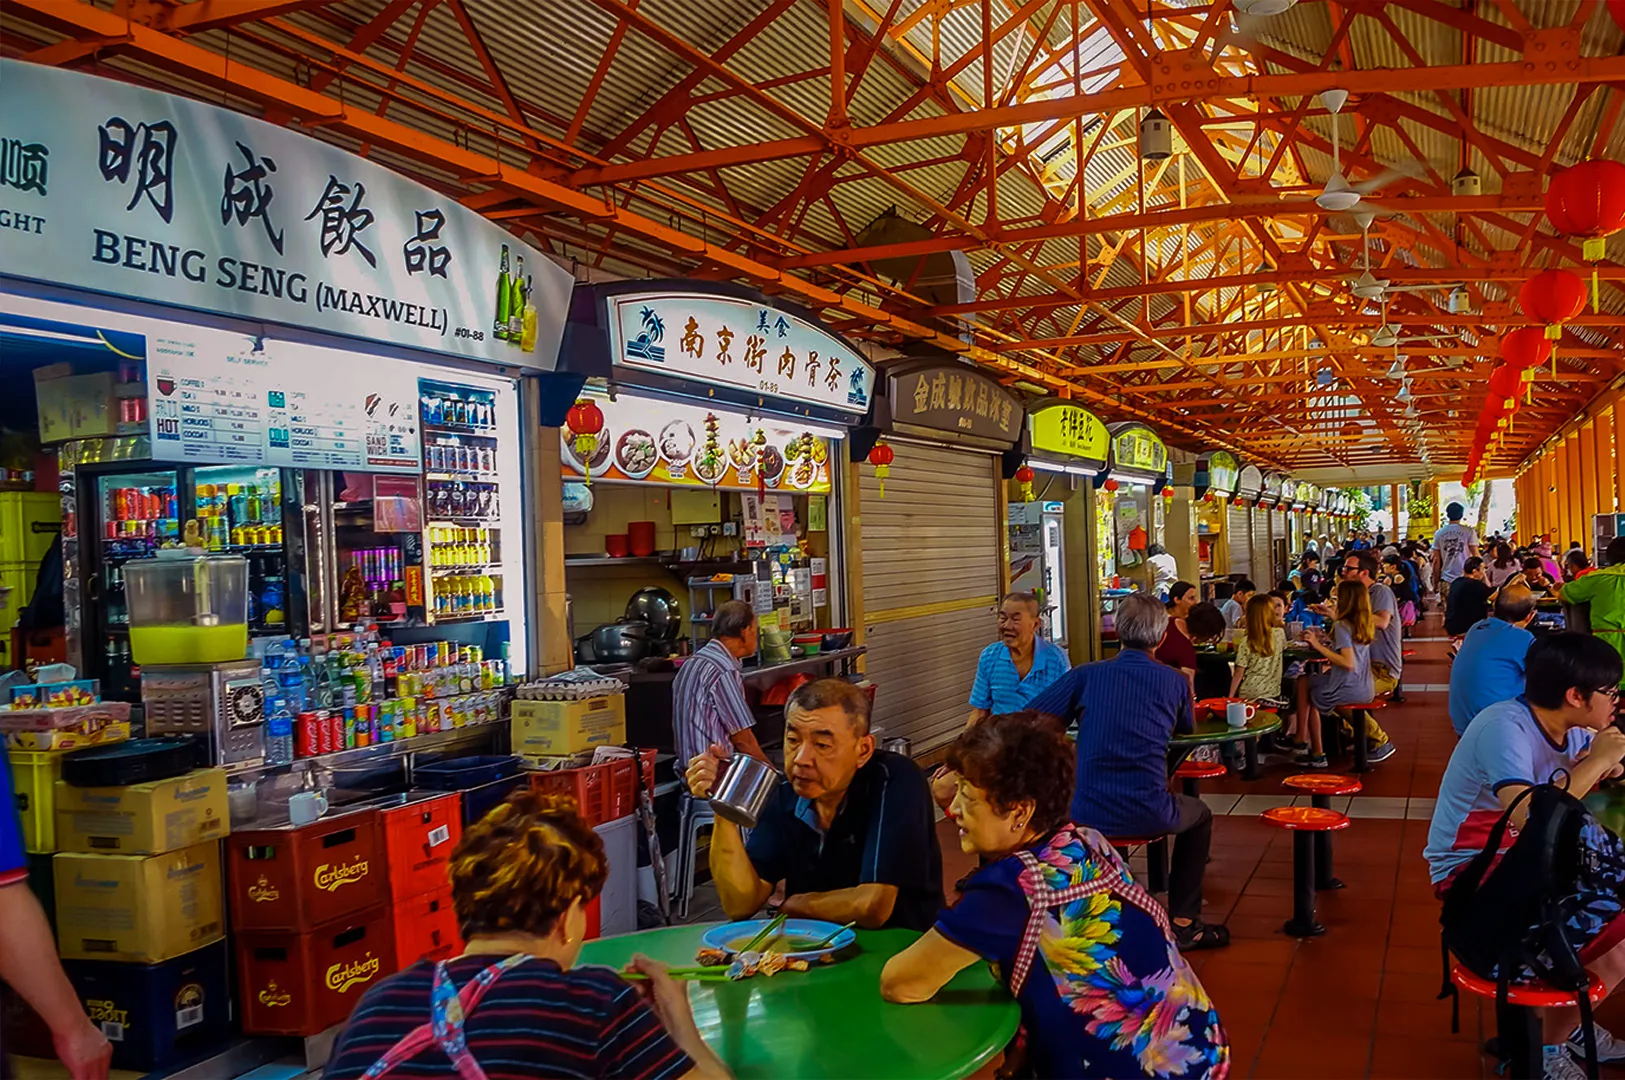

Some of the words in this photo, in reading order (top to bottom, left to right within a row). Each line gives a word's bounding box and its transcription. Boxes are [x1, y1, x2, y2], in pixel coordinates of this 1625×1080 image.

[92, 228, 206, 283] BENG
[216, 257, 307, 304] SENG
[315, 281, 448, 337] (MAXWELL)
[454, 326, 485, 342] #01-88
[756, 309, 791, 339] 美食
[679, 315, 844, 392] 南京街肉骨茶
[156, 418, 179, 434] HOT
[365, 435, 387, 447] SAND
[314, 859, 369, 891] Carlsberg
[325, 956, 380, 993] Carlsberg
